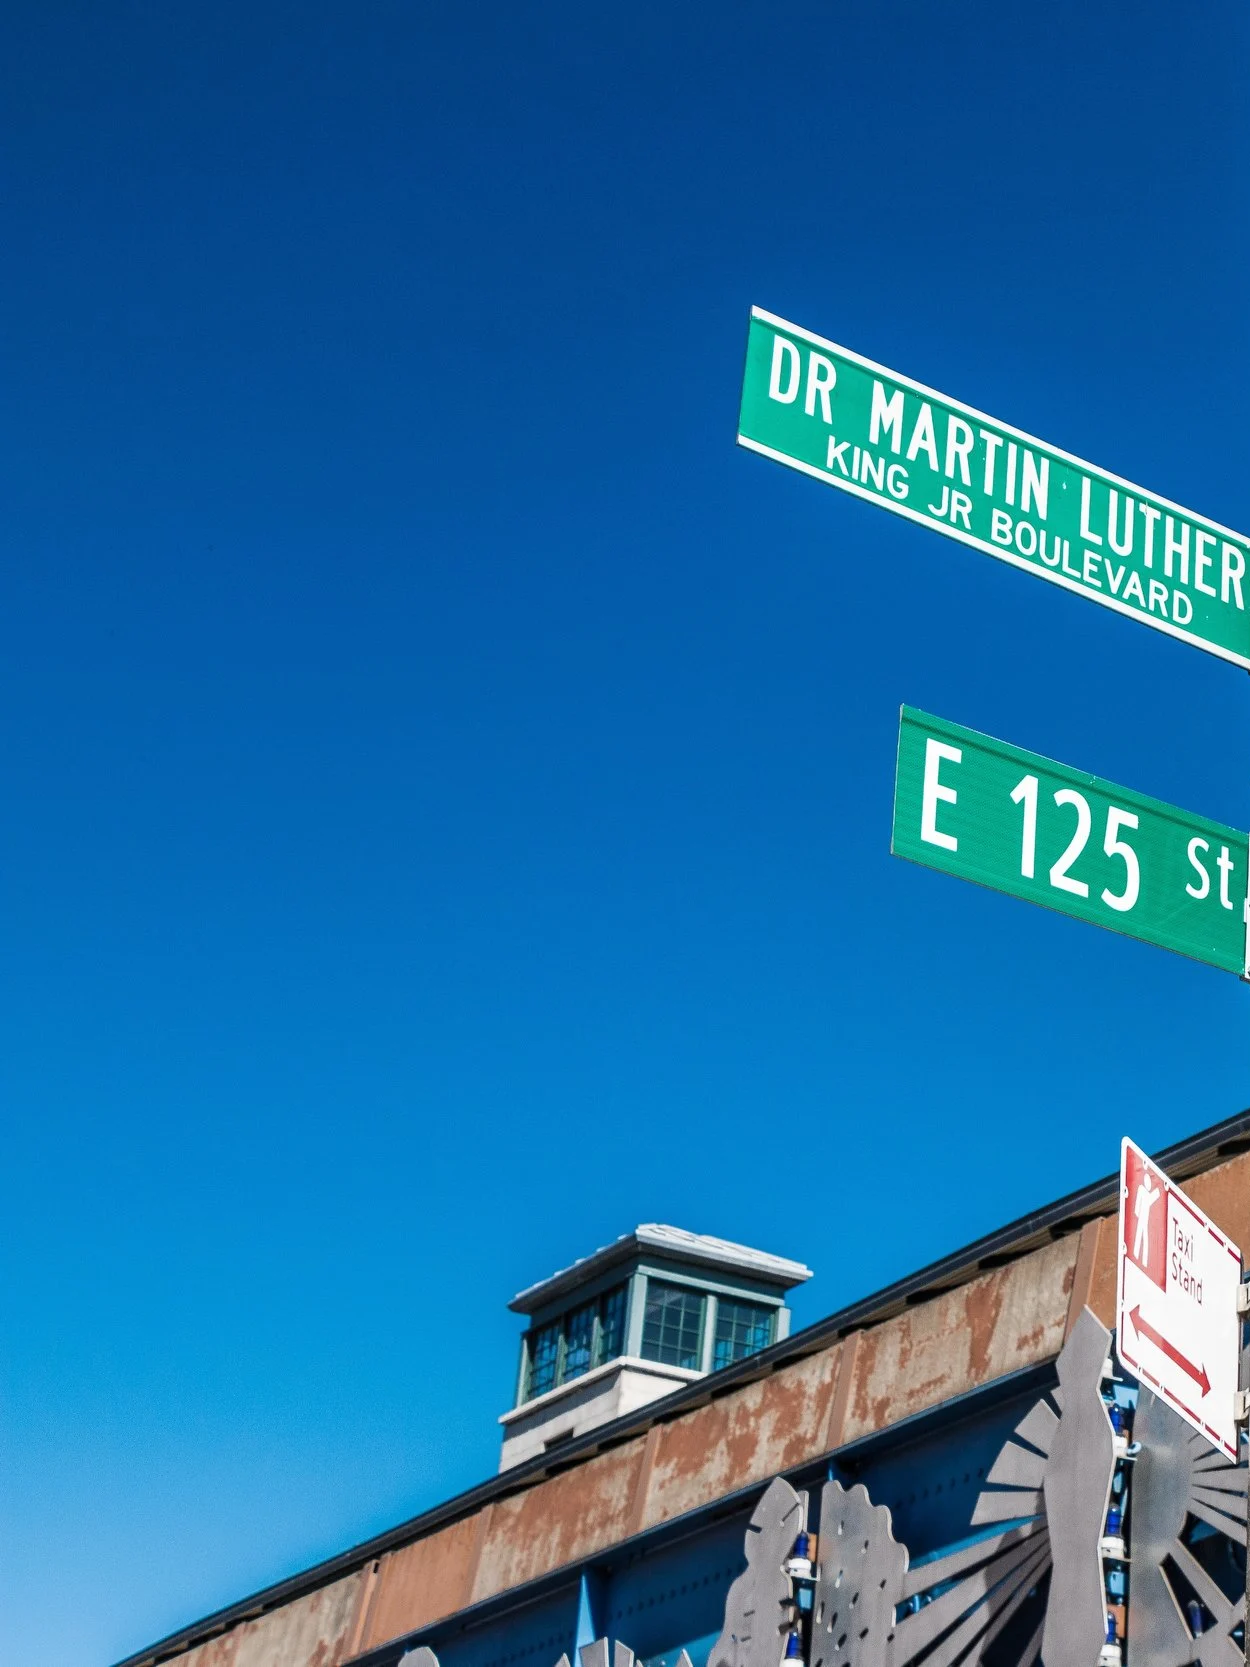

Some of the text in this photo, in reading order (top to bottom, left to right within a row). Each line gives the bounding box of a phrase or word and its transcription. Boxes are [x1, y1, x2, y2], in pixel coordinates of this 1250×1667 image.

[769, 334, 1246, 611] DR MARTIN LUTHER
[826, 435, 1194, 625] KING JR BOULEVARD
[920, 737, 1235, 912] E 125 St
[1171, 1251, 1203, 1306] Stand
[1172, 1216, 1194, 1262] Taxi
